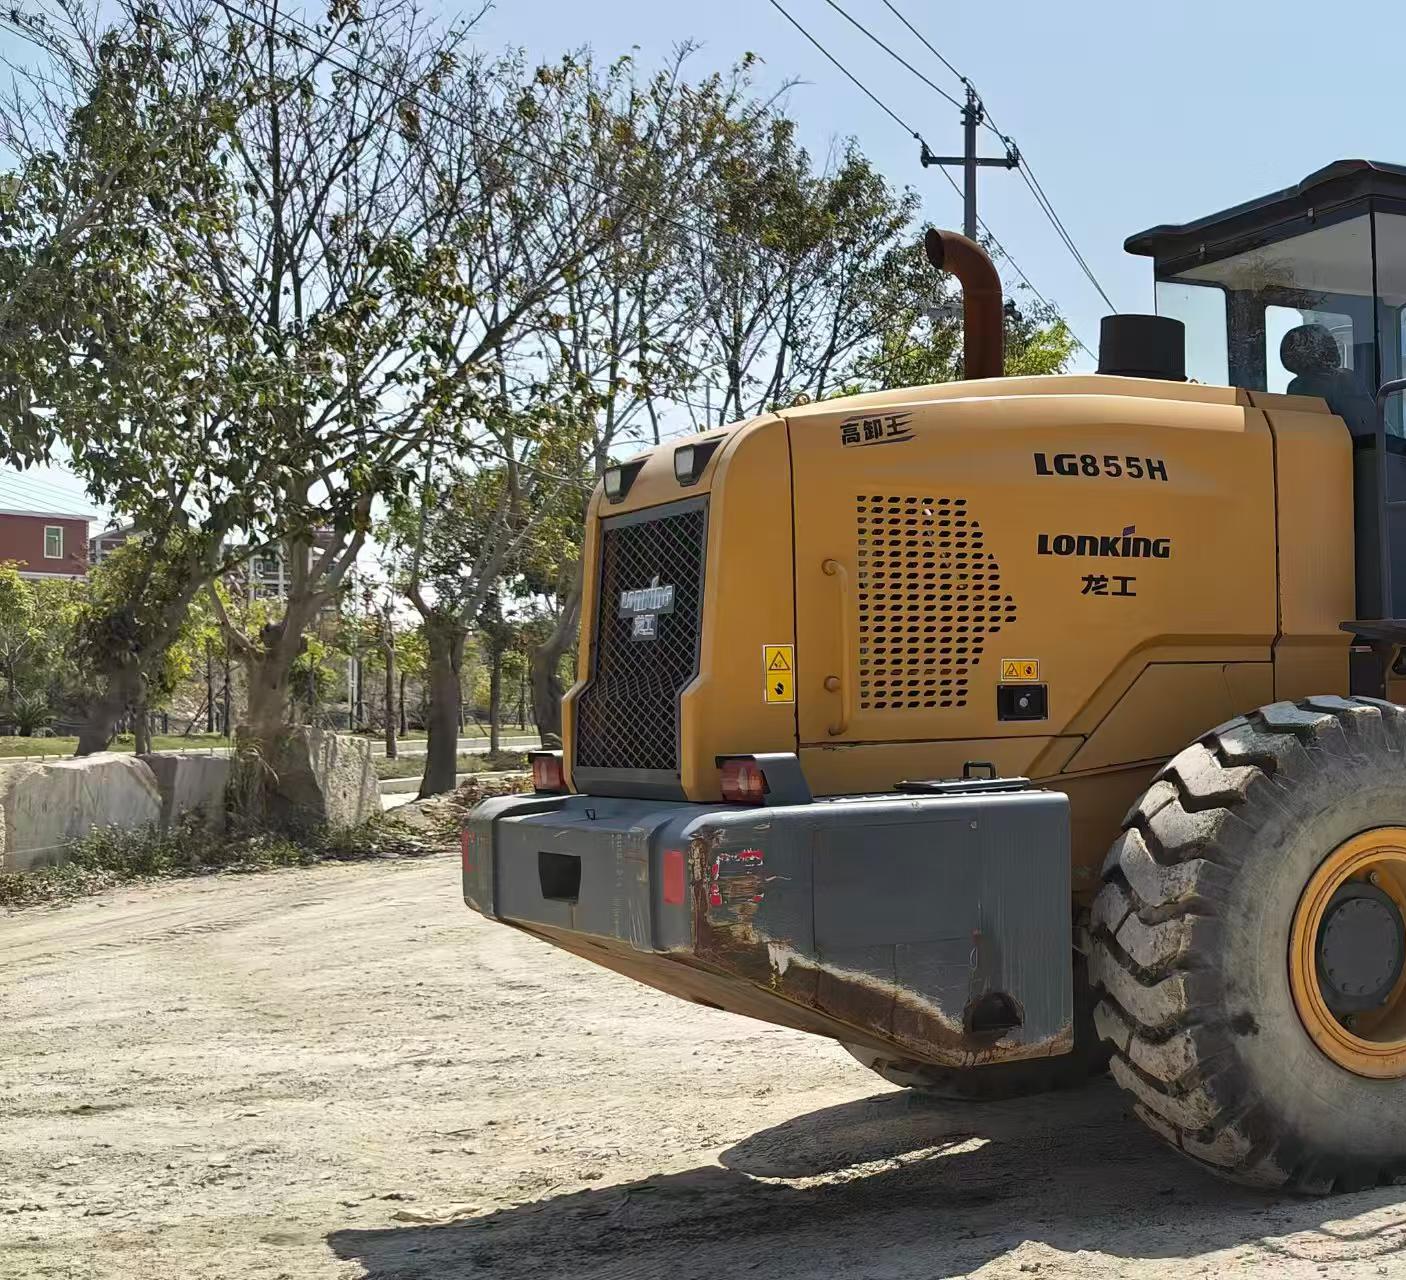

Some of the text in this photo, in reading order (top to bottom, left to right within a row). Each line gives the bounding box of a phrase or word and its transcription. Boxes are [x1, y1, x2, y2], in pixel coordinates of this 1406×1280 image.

[840, 412, 912, 446] 高卸王
[1033, 452, 1169, 481] LG855H
[1081, 575, 1137, 597] 龙工
